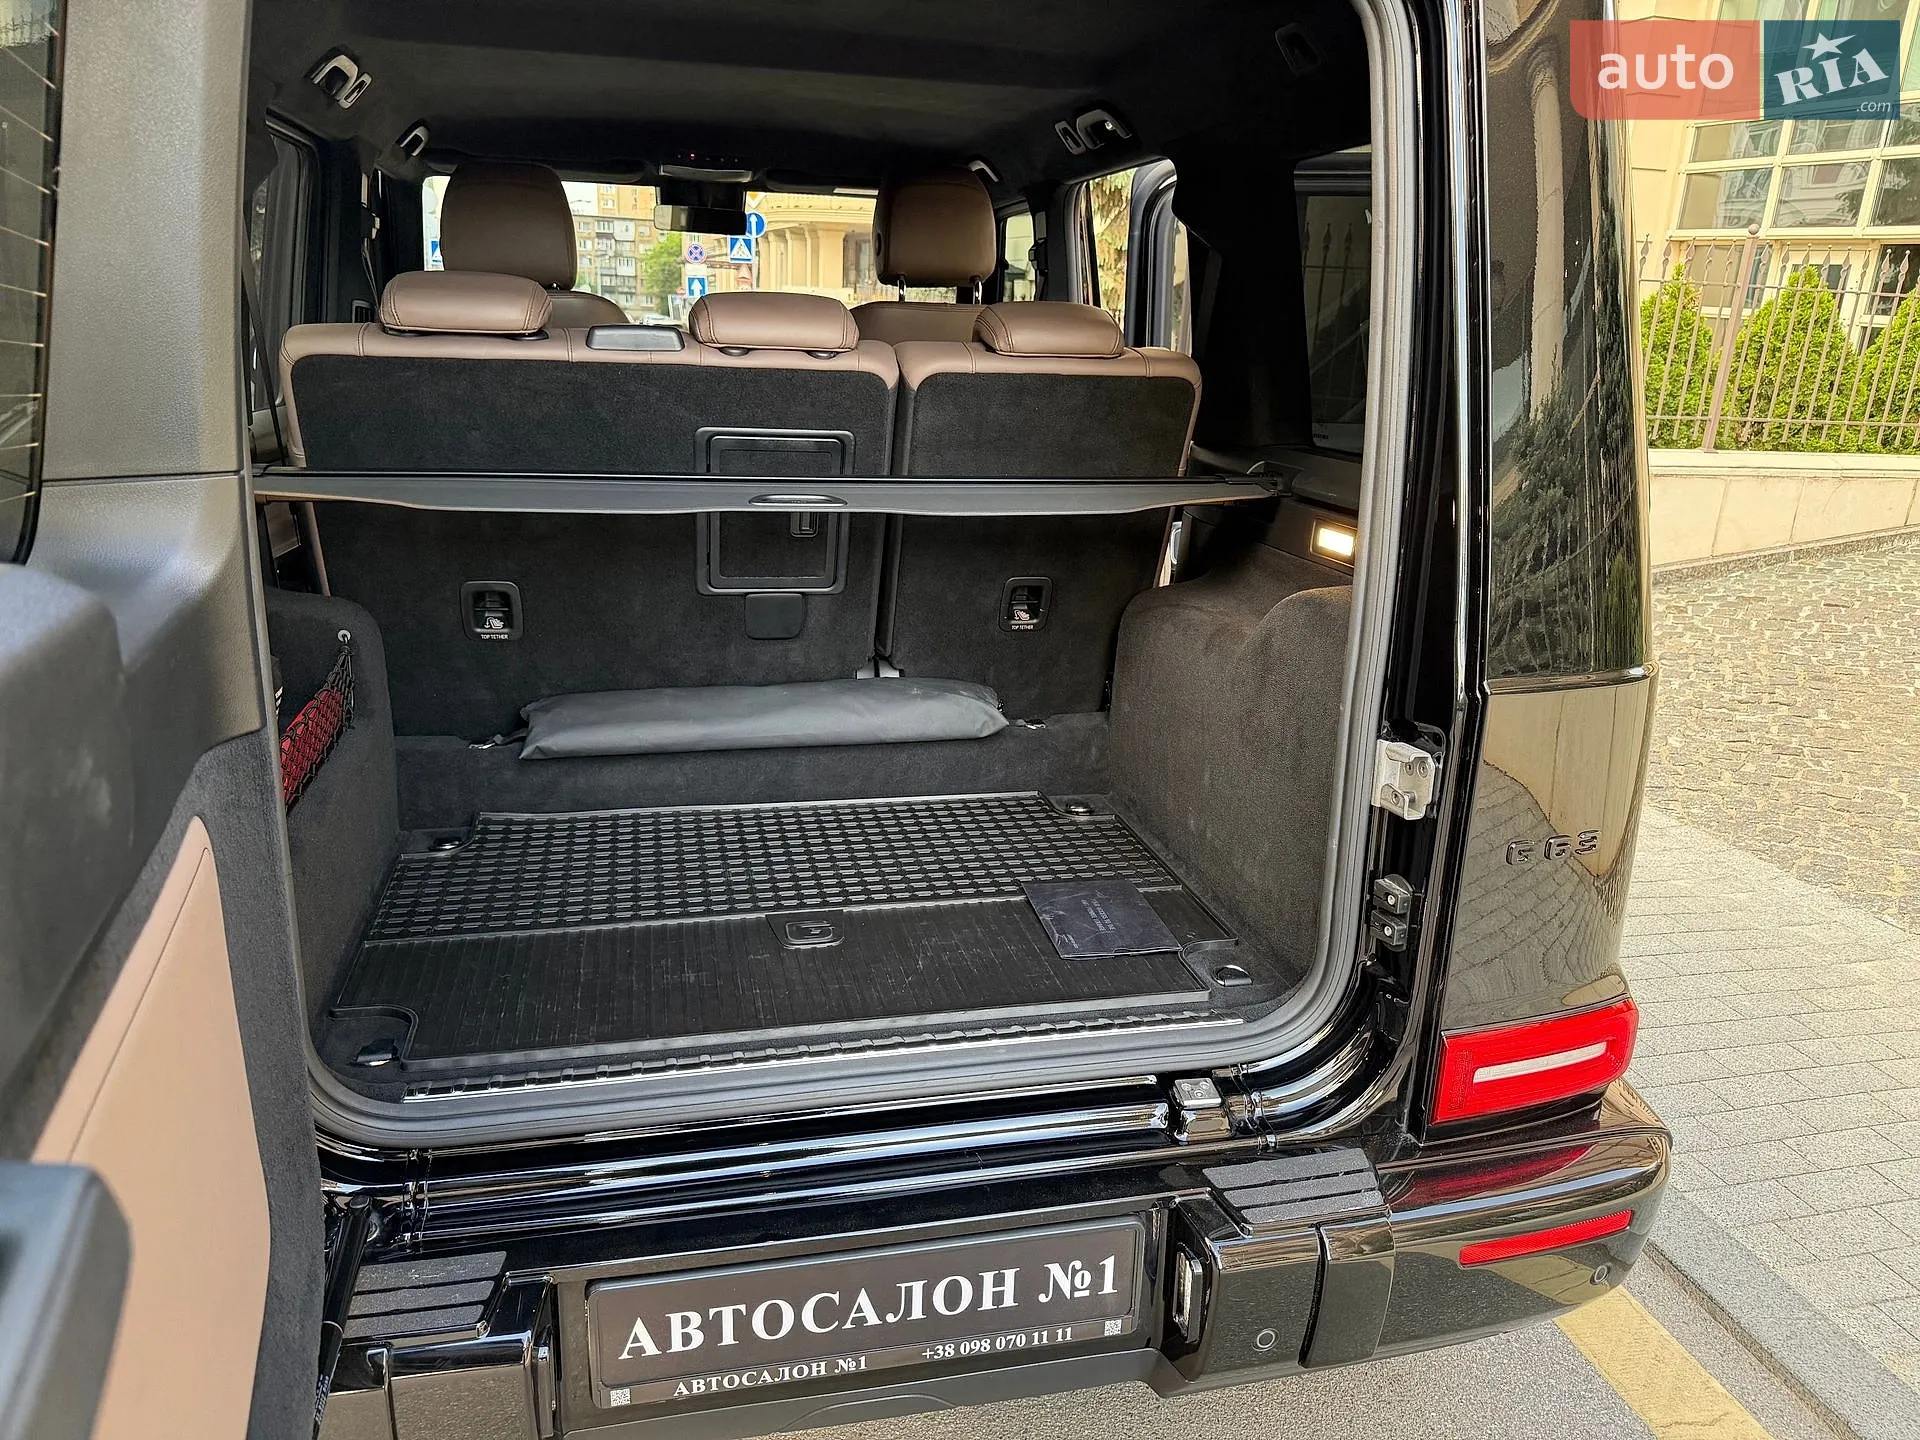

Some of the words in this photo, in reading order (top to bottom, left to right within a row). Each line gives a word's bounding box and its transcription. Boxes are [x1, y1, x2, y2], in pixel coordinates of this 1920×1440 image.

[1506, 839, 1535, 866] G
[1544, 830, 1602, 861] 63
[617, 1267, 1020, 1360] АВТОСАЛОН
[1038, 1255, 1119, 1303] №1
[921, 1344, 955, 1360] +38
[960, 1338, 991, 1355] 098
[996, 1333, 1026, 1350] 070
[1031, 1329, 1049, 1346] 11
[1055, 1326, 1073, 1343] 11
[673, 1361, 828, 1396] АВТОСАЛОН
[834, 1356, 868, 1375] №1
